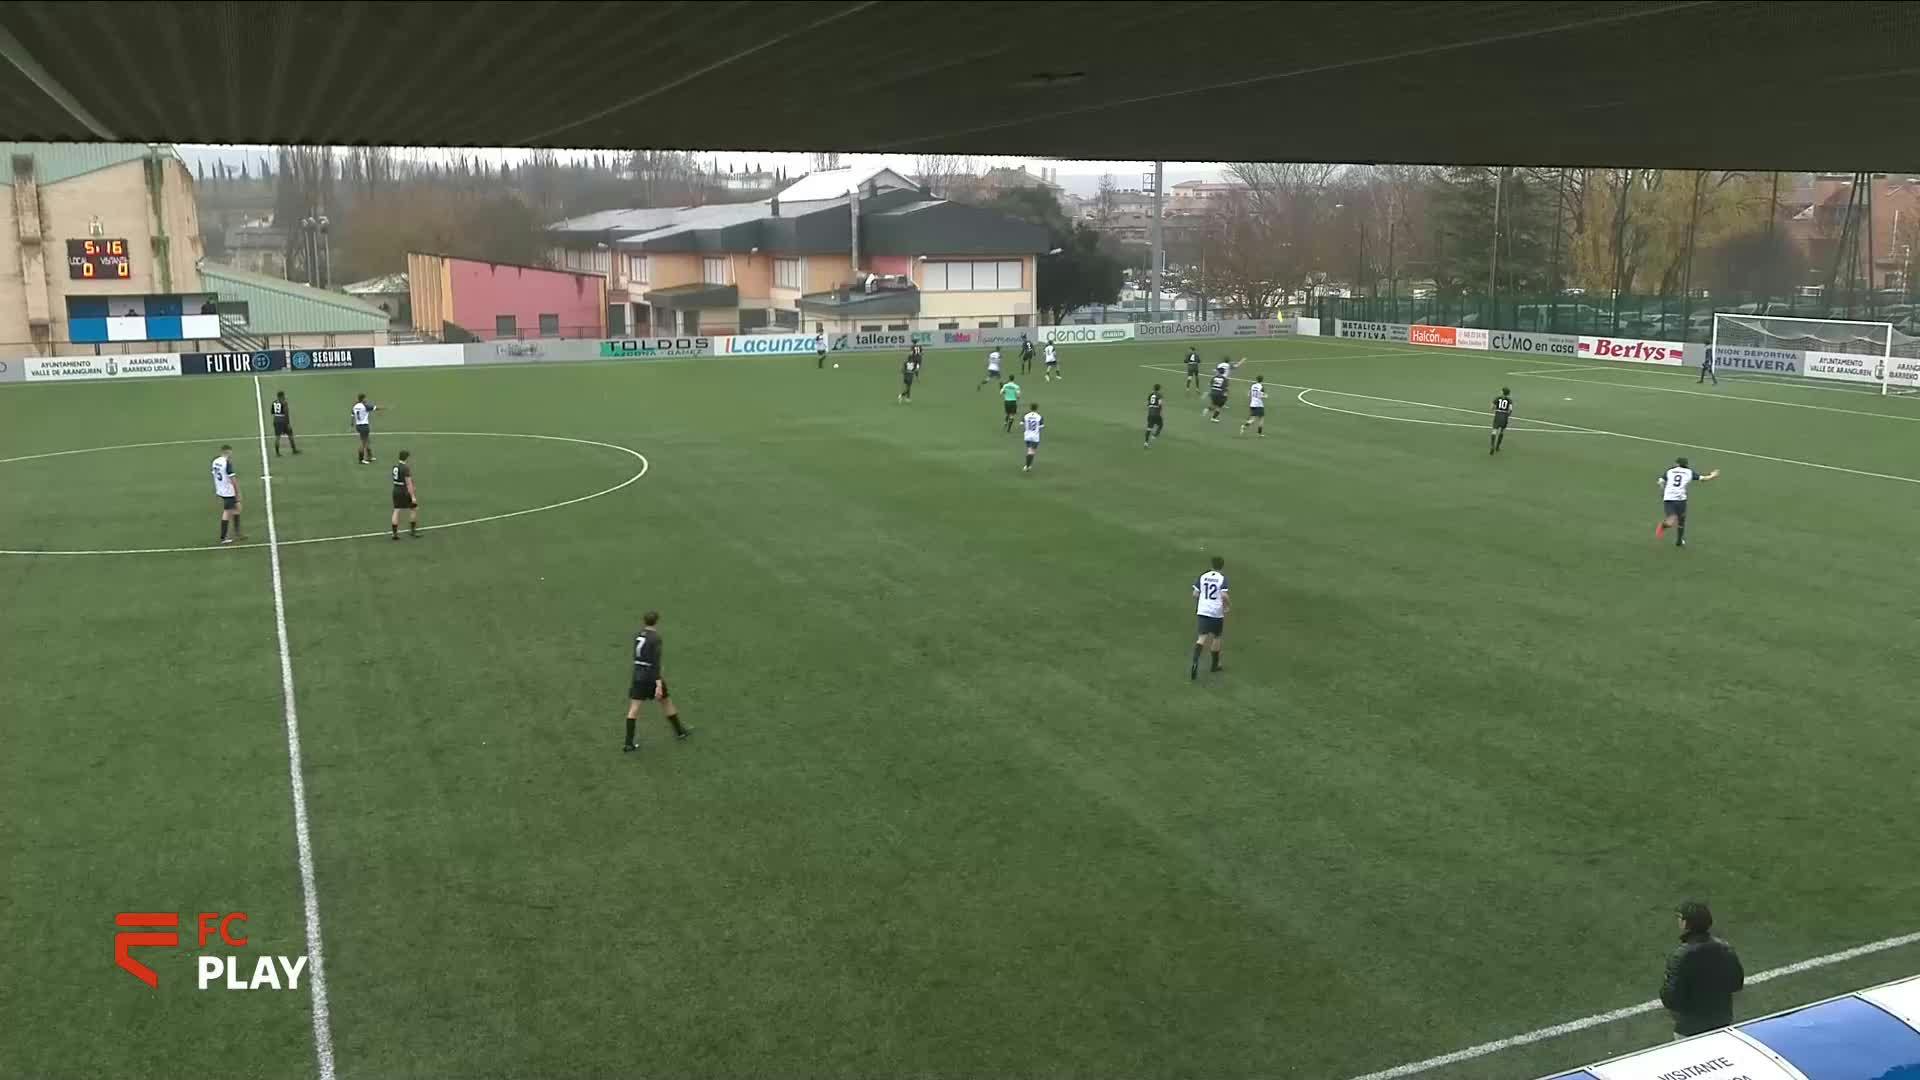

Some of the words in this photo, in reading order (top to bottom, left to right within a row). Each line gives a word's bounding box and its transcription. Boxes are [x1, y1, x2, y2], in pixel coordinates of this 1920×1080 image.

[83, 262, 93, 277] 0
[118, 262, 128, 277] 0
[855, 333, 905, 345] talleres
[1046, 328, 1096, 342] denda
[1342, 330, 1387, 340] MUTILVA
[608, 338, 709, 353] TOLDOS
[1535, 342, 1547, 351] en
[1550, 343, 1574, 354] casa
[1594, 339, 1666, 361] Berlys
[312, 351, 352, 364] SEGUNDA
[1743, 350, 1797, 360] DEPORTIVA
[41, 360, 91, 368] AYUNTAMIENTO
[31, 368, 50, 376] VALLE
[52, 368, 61, 376] DE
[62, 367, 102, 375] ARANGUREN
[1498, 399, 1509, 410] 10
[394, 467, 399, 481] 9
[1673, 474, 1683, 487] 9
[1204, 582, 1218, 600] 12
[635, 636, 646, 657] 7
[1657, 1057, 1734, 1080] VISITANTE
